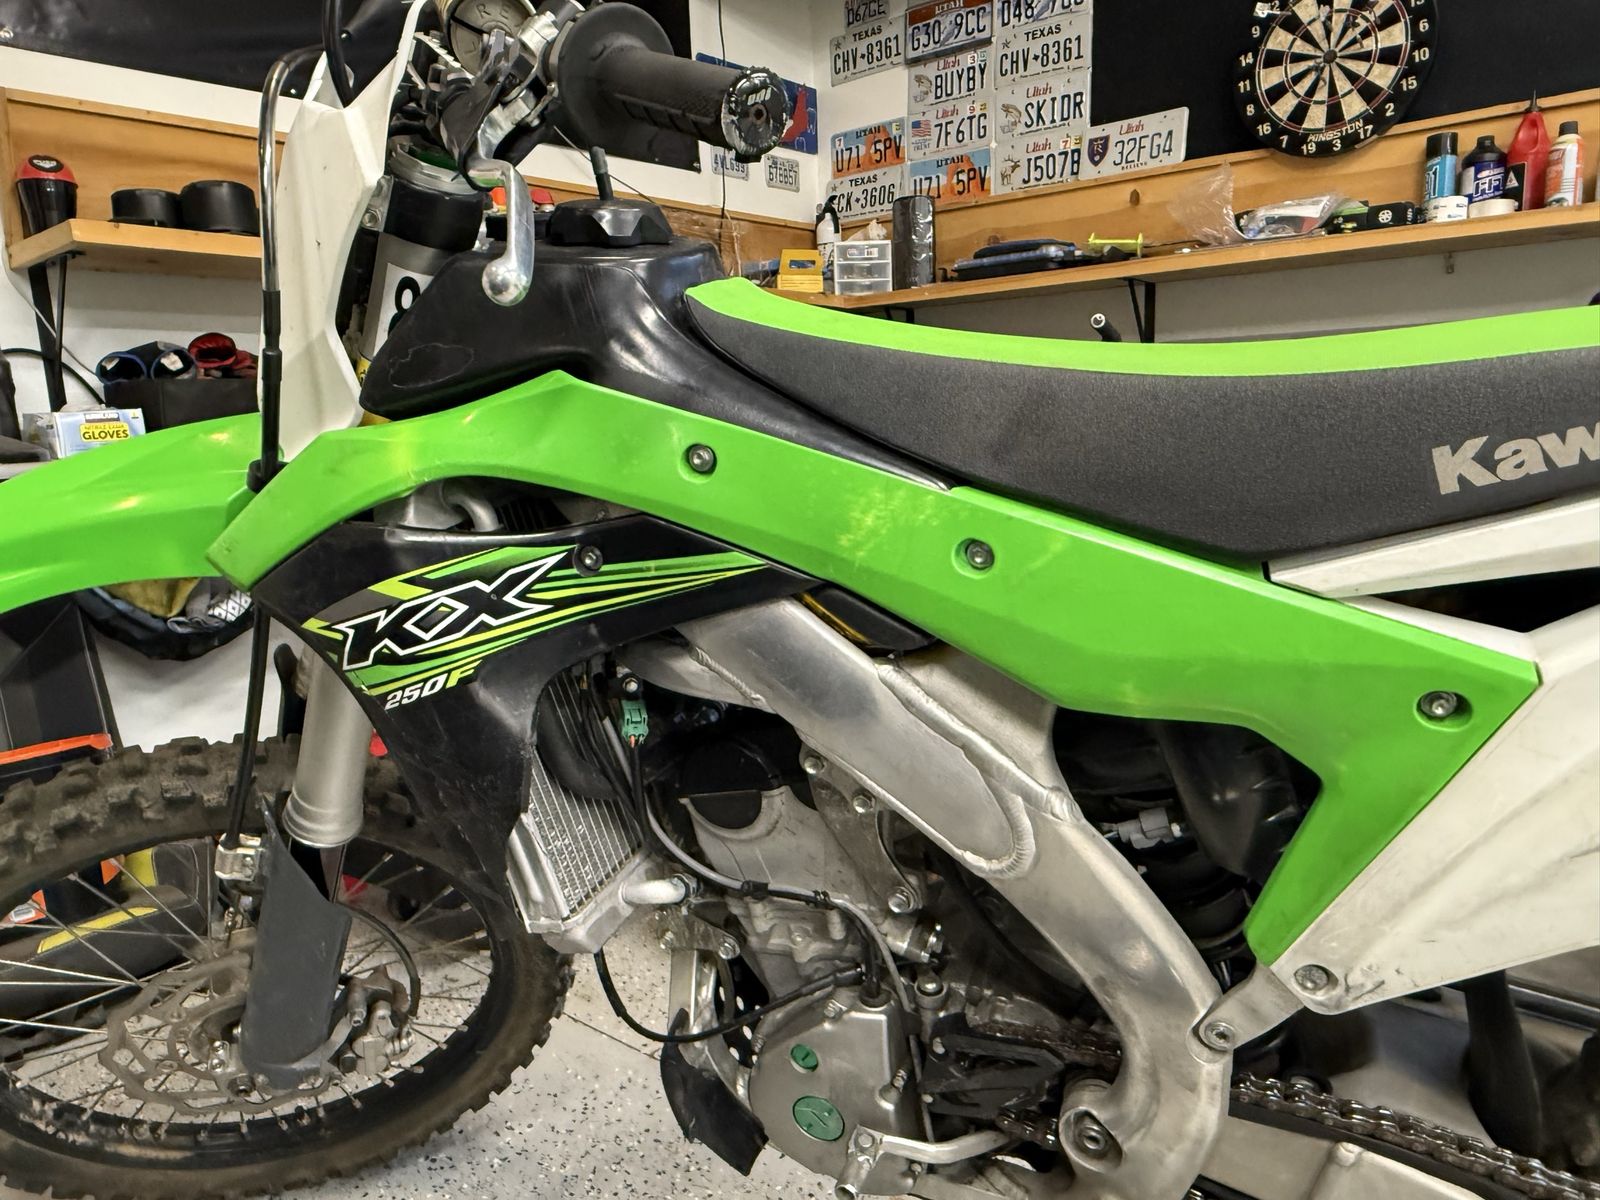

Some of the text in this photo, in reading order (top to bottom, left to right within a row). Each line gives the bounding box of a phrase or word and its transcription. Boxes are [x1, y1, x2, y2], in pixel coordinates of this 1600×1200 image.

[912, 6, 986, 51] G30 9CC
[1024, 24, 1061, 41] TEXAS
[1251, 25, 1260, 38] 9
[1419, 18, 1429, 33] 6
[853, 25, 882, 42] TEXAS
[834, 47, 857, 75] CHV
[867, 34, 901, 65] 8361
[1000, 47, 1029, 76] CHV
[1041, 34, 1083, 67] 8361
[1239, 52, 1254, 67] 14
[1412, 47, 1430, 63] 10
[937, 55, 960, 71] Utah
[935, 62, 987, 100] BUYBY
[1238, 79, 1250, 93] 11
[1400, 76, 1418, 92] 15
[1027, 82, 1052, 98] Utah
[936, 104, 959, 119] Utah
[1246, 104, 1255, 116] 8
[1384, 102, 1395, 117] 2
[856, 125, 881, 139] UTAH
[934, 113, 987, 148] 7F6TG
[1120, 120, 1144, 135] Utah
[1256, 123, 1272, 136] 16
[1358, 125, 1373, 139] 17
[1026, 138, 1051, 153] Utah
[1113, 130, 1173, 166] 32FG4
[1280, 135, 1289, 149] 7
[1301, 142, 1316, 155] 19
[1332, 139, 1342, 151] 3
[836, 144, 861, 172] U71
[874, 134, 902, 164] 5PV
[936, 154, 963, 168] UTAH
[849, 174, 878, 187] TEXAS
[956, 165, 987, 196] 5PV
[837, 192, 853, 213] CK
[861, 183, 895, 209] 3606
[82, 429, 129, 440] GLOVES
[385, 660, 482, 710] 250F
